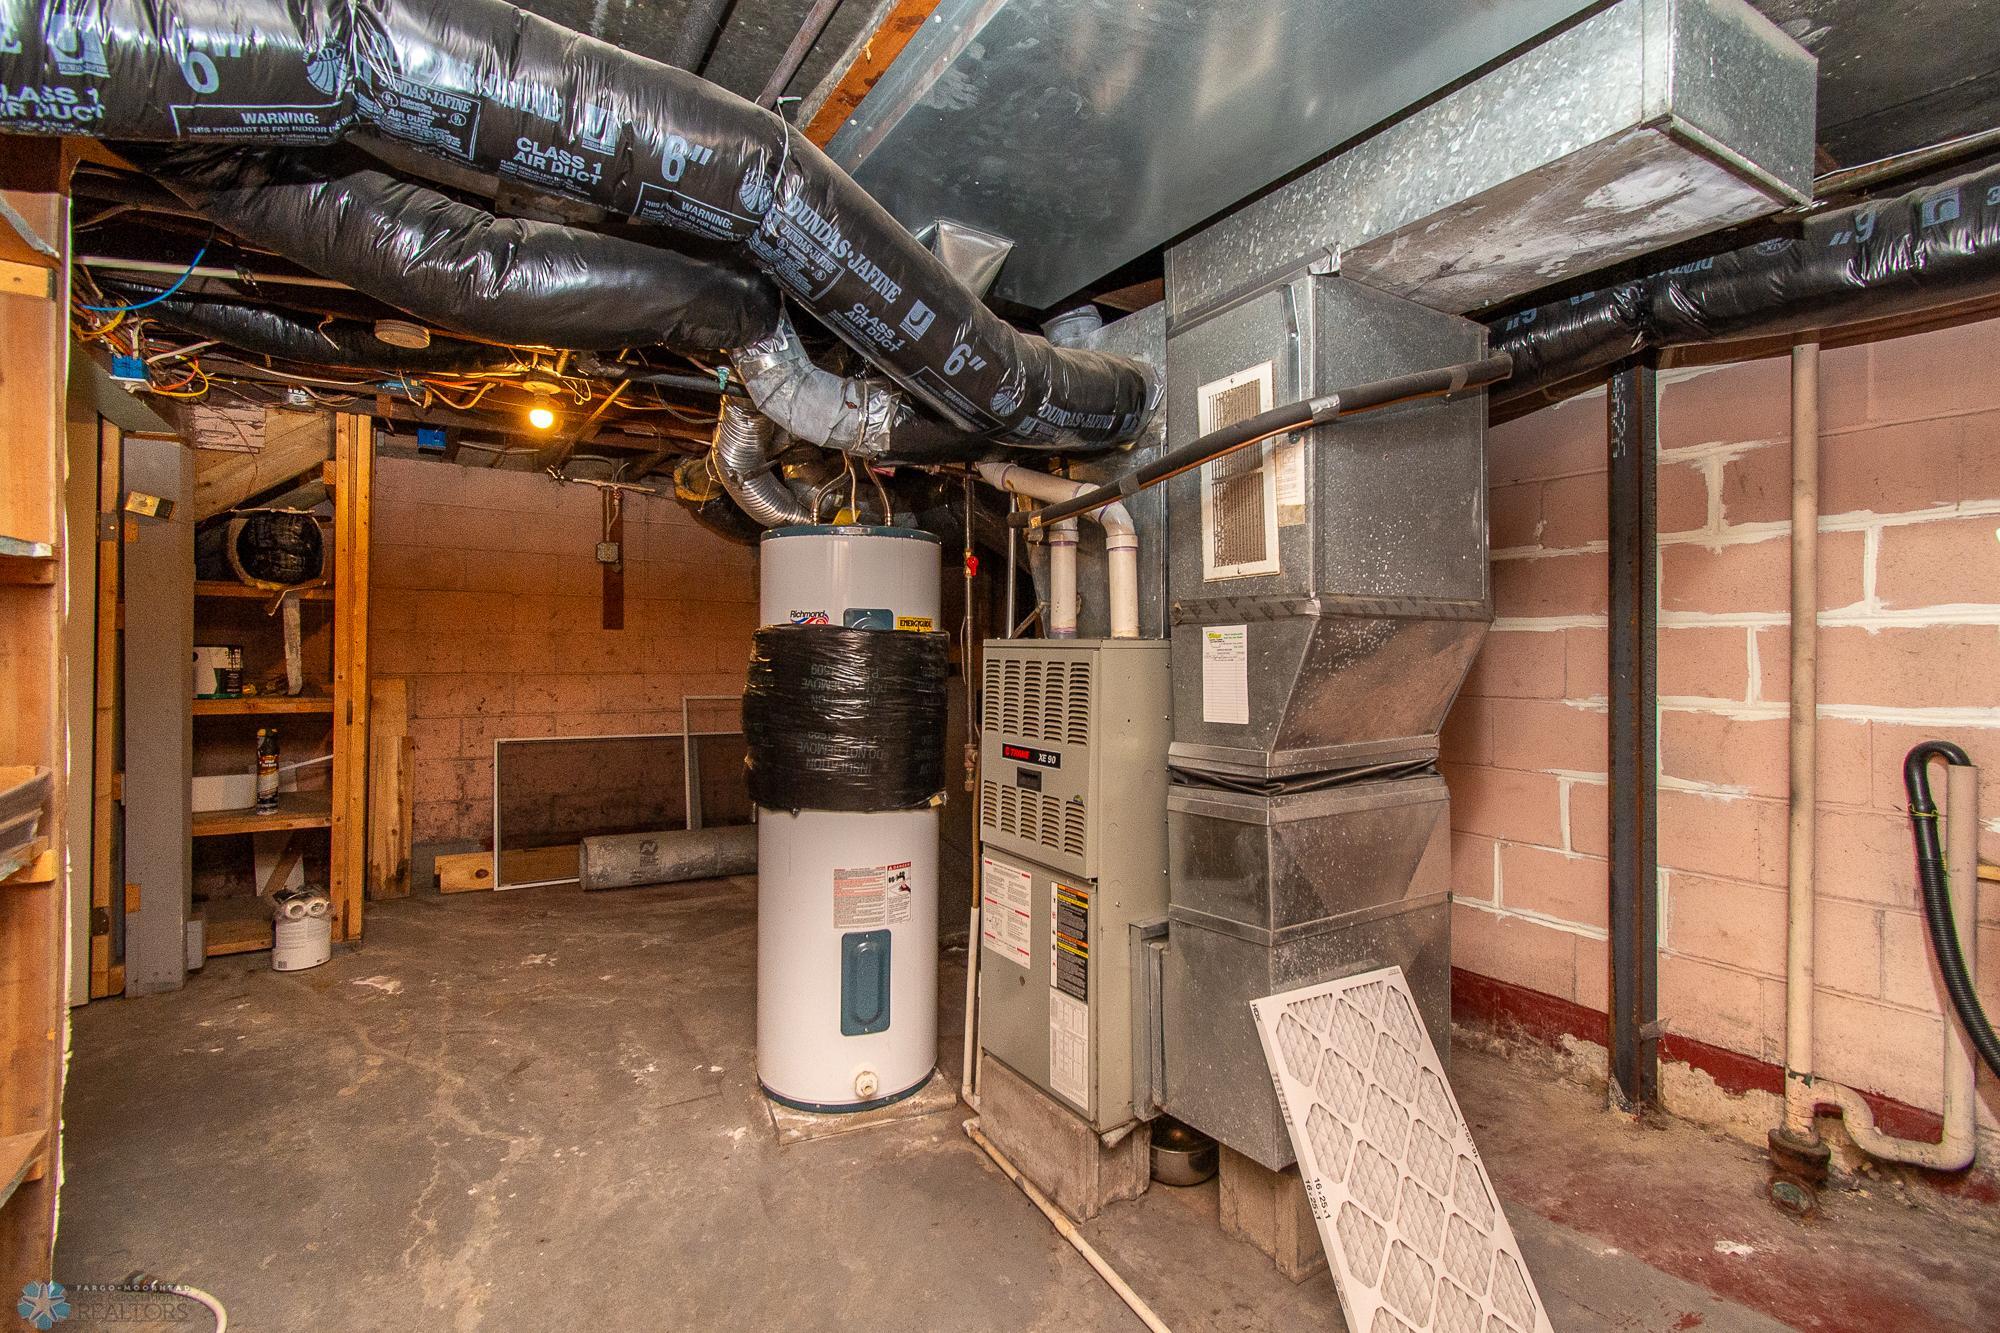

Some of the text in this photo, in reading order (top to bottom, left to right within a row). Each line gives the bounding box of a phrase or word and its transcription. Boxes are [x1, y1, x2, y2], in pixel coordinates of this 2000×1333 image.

[0, 82, 79, 105] LASS
[240, 111, 319, 125] WARNING:
[513, 150, 603, 185] AIR DUCT
[516, 136, 602, 175] CLASS 1
[661, 134, 713, 183] 6"
[681, 200, 733, 230] WARNING:
[844, 310, 867, 328] AIR
[866, 326, 900, 352] DUCT
[853, 303, 896, 339] CLASS
[943, 343, 987, 376] 6"
[789, 609, 826, 619] Richmond
[1038, 753, 1048, 763] XE
[1047, 755, 1057, 765] 90
[1251, 1003, 1261, 1022] HDX
